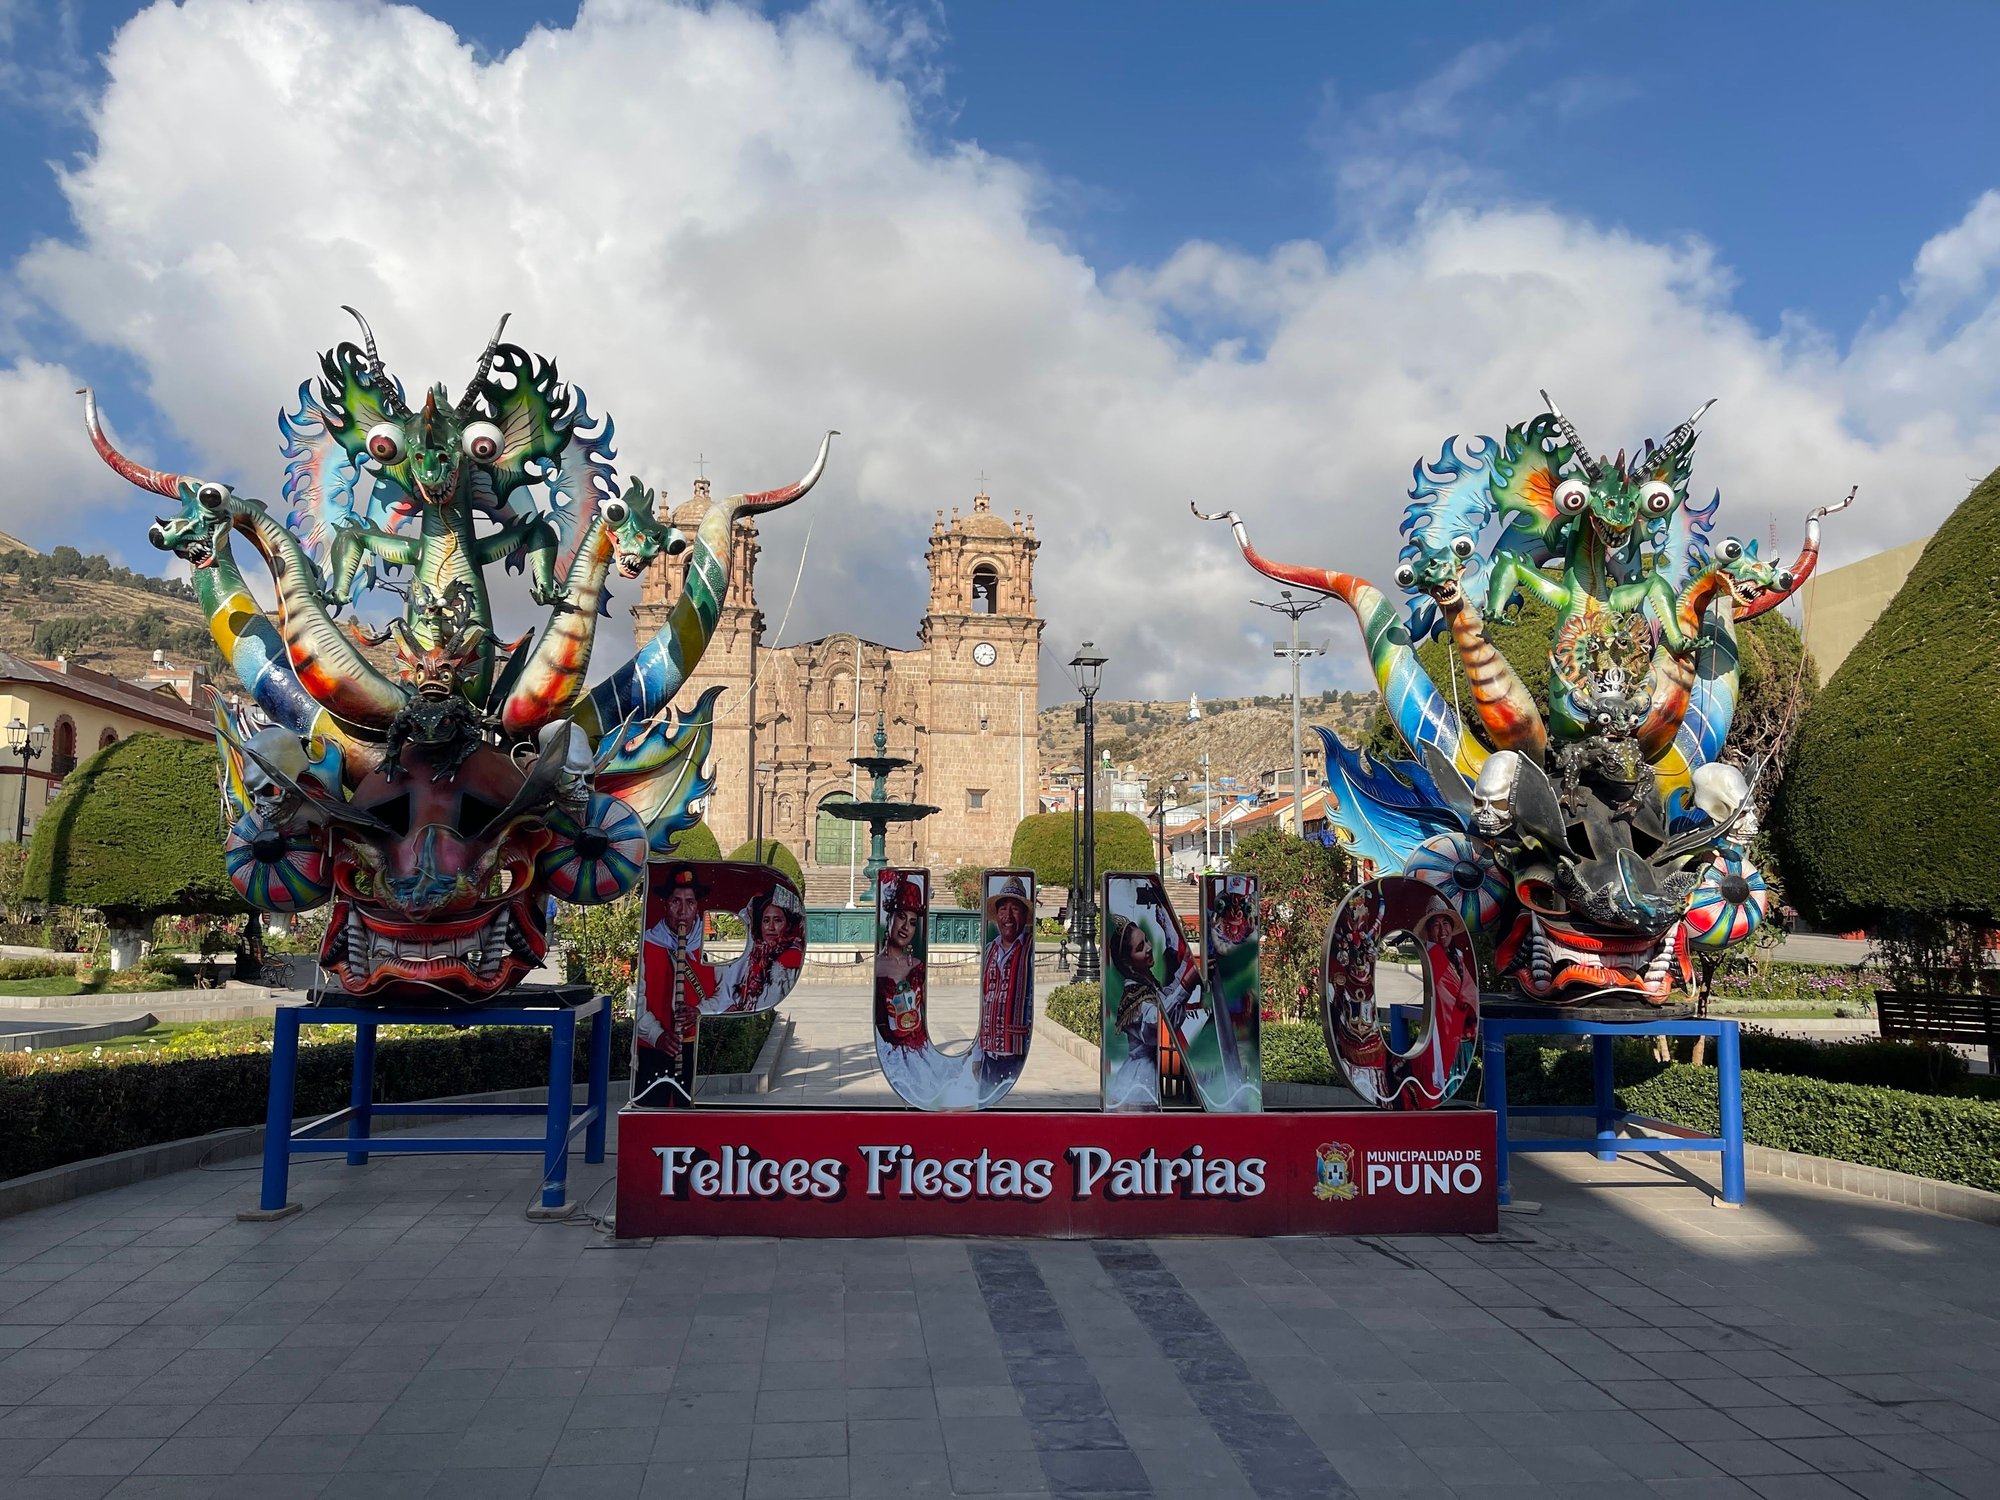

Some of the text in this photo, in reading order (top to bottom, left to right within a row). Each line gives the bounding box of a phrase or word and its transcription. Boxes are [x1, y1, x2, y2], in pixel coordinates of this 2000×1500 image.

[631, 860, 1480, 1112] PUNO
[652, 1144, 1267, 1198] Felices Fiestas Patrias
[1367, 1150, 1481, 1162] MUNICIPALIDAD DE
[1367, 1162, 1482, 1195] PUNO
